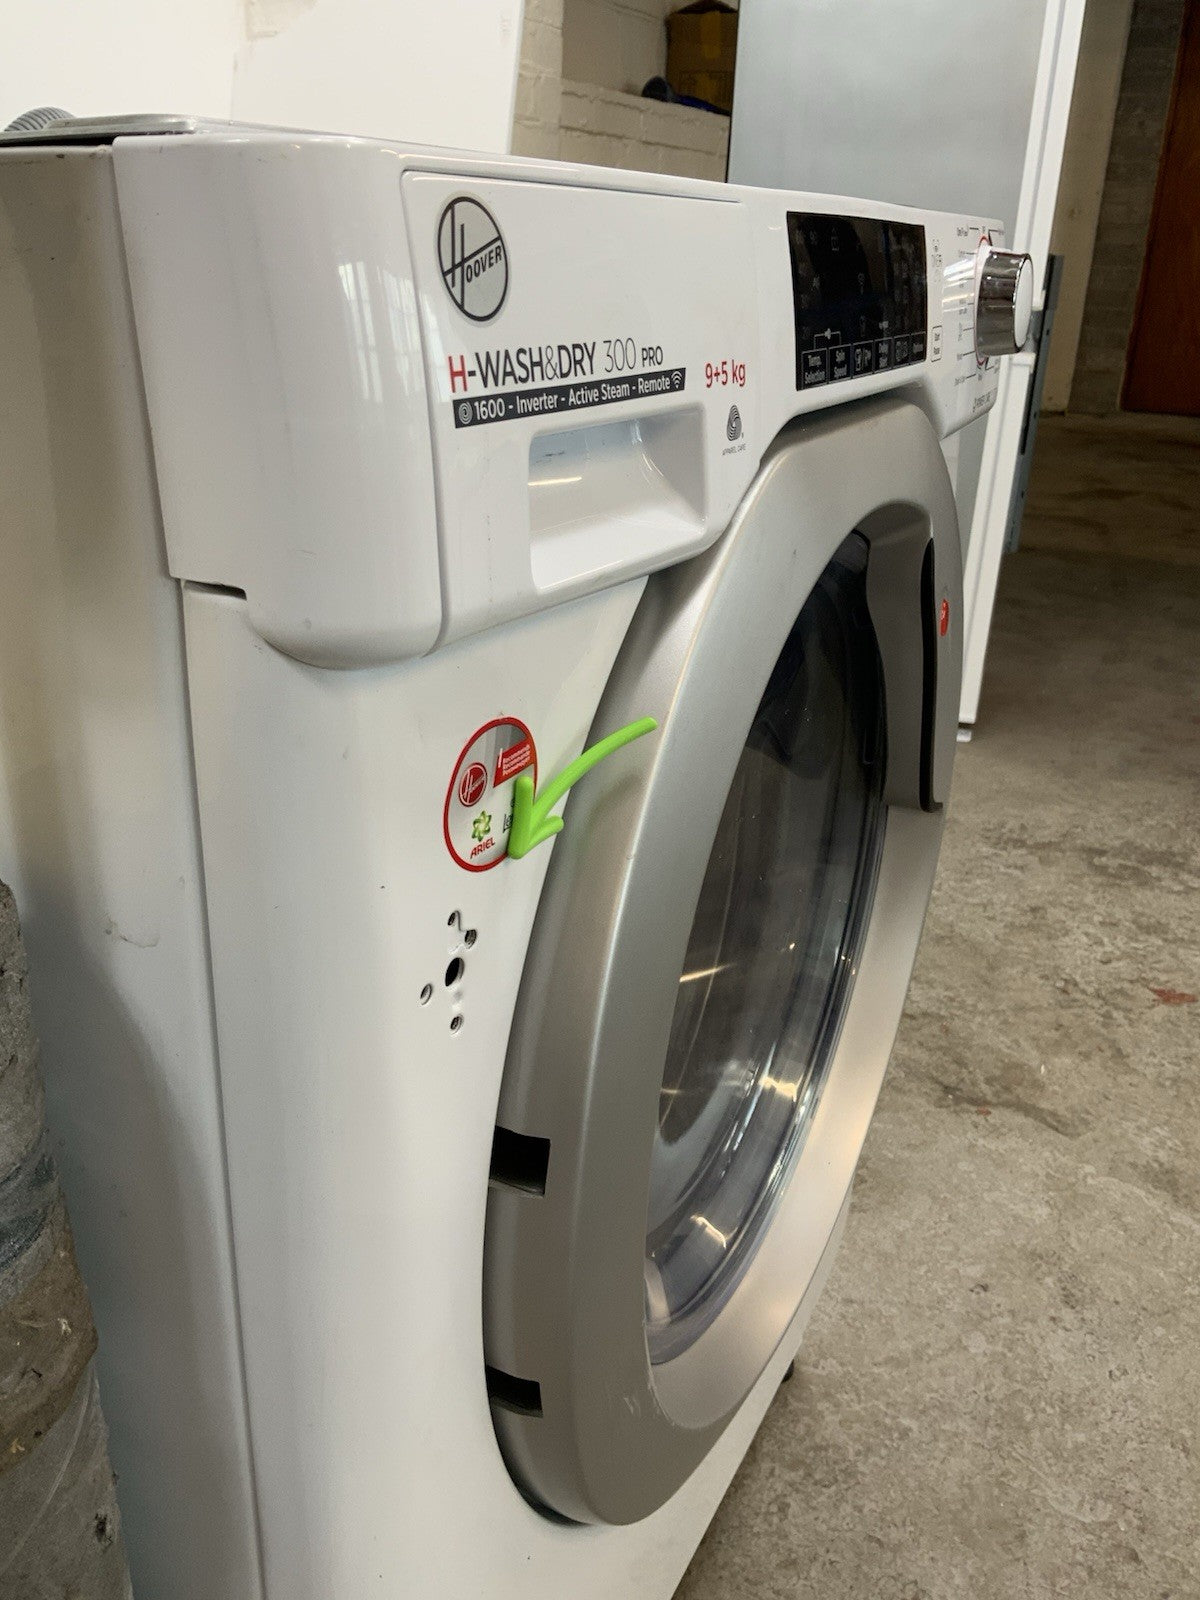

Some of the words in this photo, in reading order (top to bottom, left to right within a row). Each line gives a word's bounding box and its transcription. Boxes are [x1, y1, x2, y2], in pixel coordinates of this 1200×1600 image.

[448, 342, 596, 393] H-WASH&DRY
[603, 337, 636, 373] 300
[641, 346, 663, 367] PRO
[705, 361, 728, 389] 9+5
[731, 359, 746, 387] kg
[474, 398, 506, 421] 1600
[516, 394, 559, 415] Inverter
[568, 386, 600, 407] Active
[601, 383, 630, 401] Steam
[638, 376, 671, 394] Remote
[470, 837, 496, 859] ARIEL
